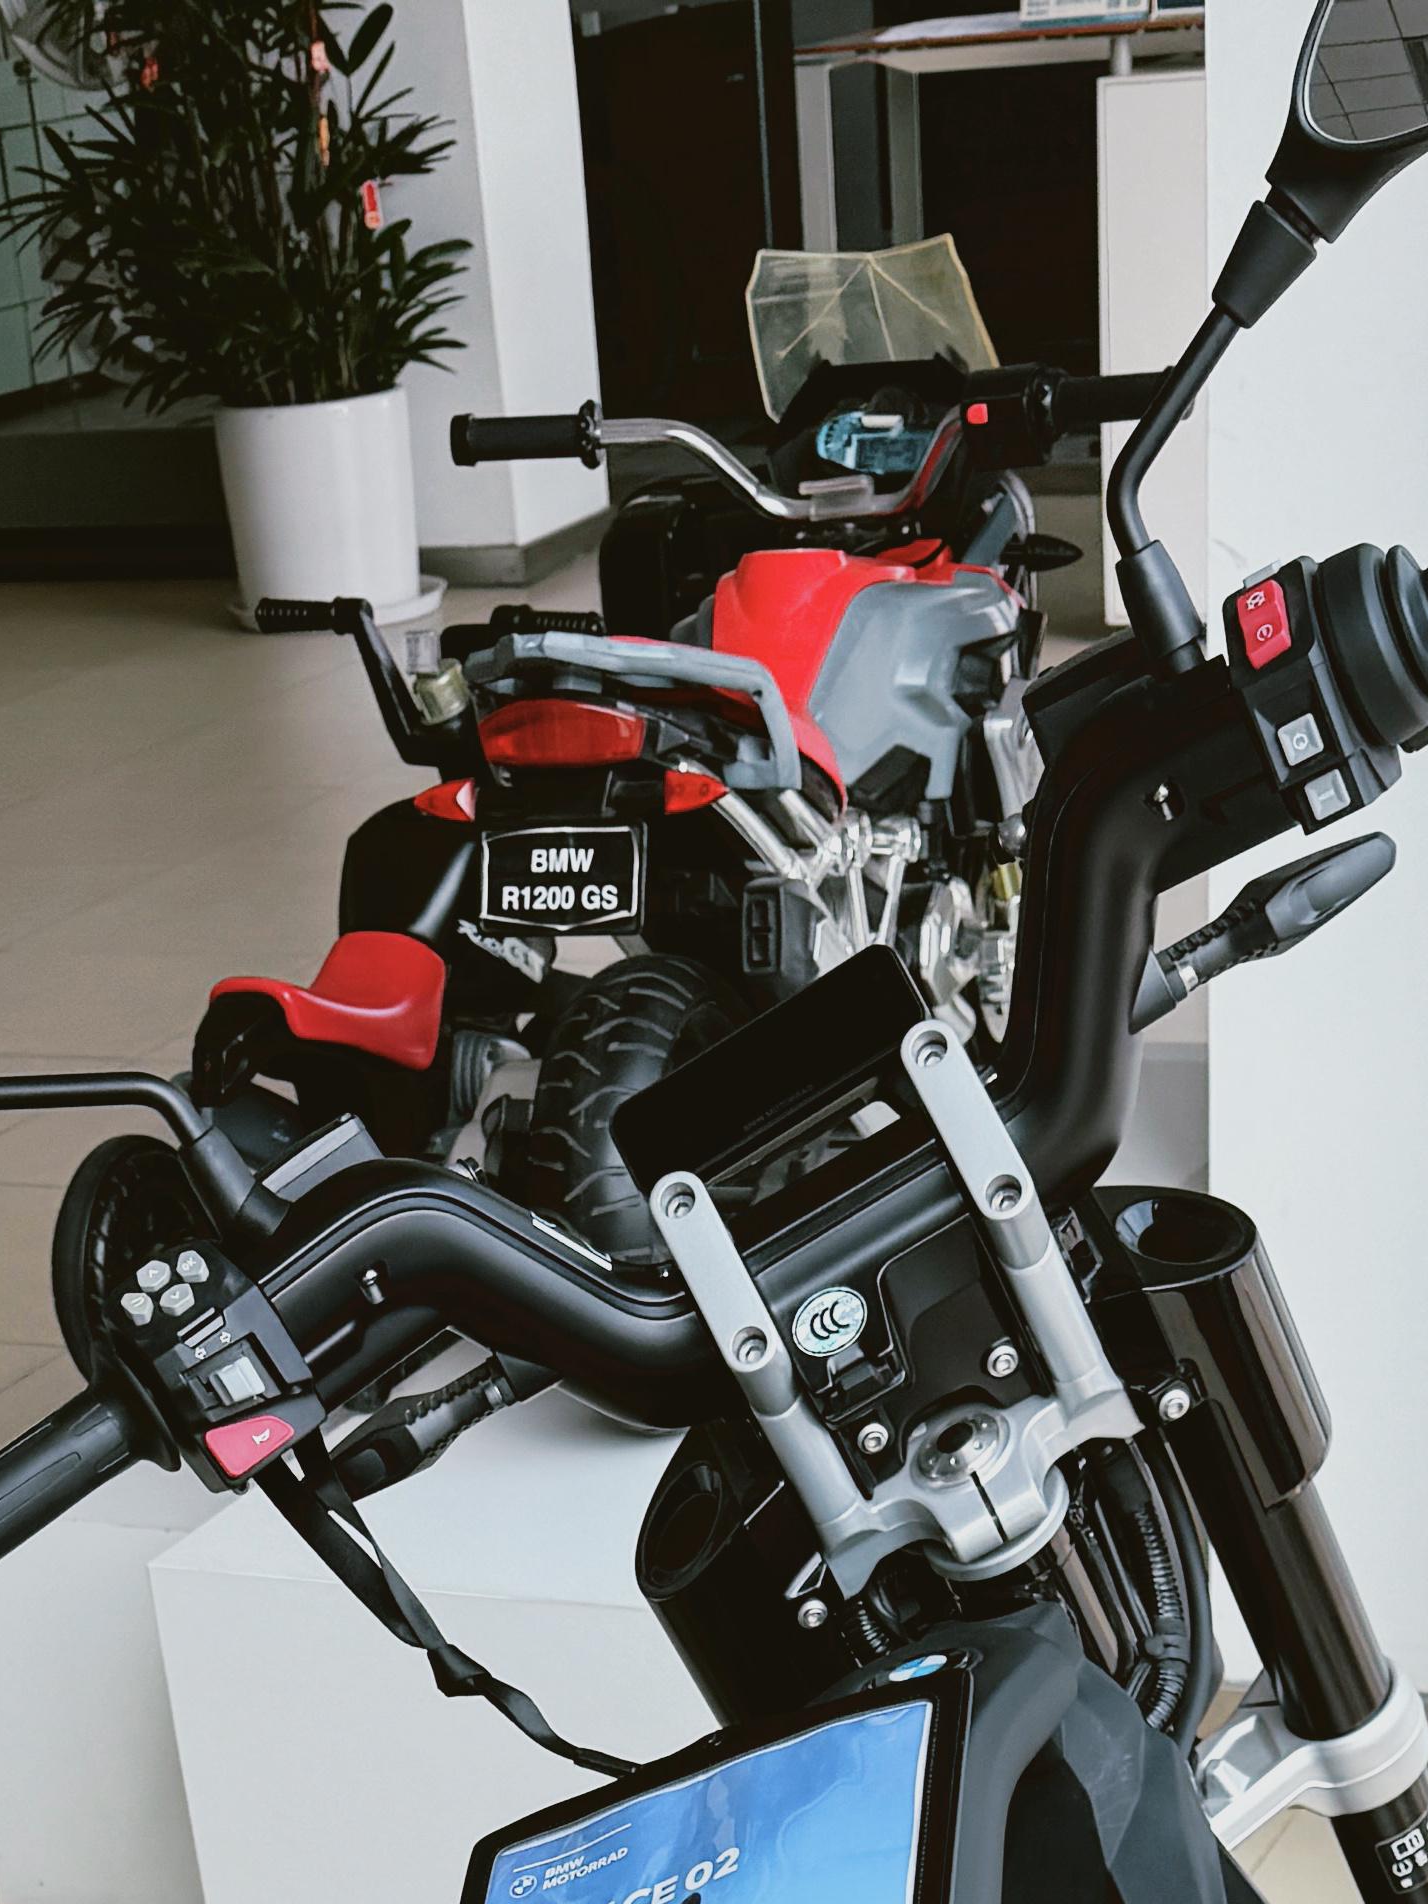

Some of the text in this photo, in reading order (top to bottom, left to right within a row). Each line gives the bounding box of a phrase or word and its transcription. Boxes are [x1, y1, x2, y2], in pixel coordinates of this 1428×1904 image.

[530, 848, 595, 873] BMW
[501, 884, 618, 911] R1200 GS
[181, 1257, 197, 1271] OK
[542, 1847, 628, 1891] MOTORRAD
[544, 1855, 585, 1880] BMW
[685, 1847, 741, 1891] 02
